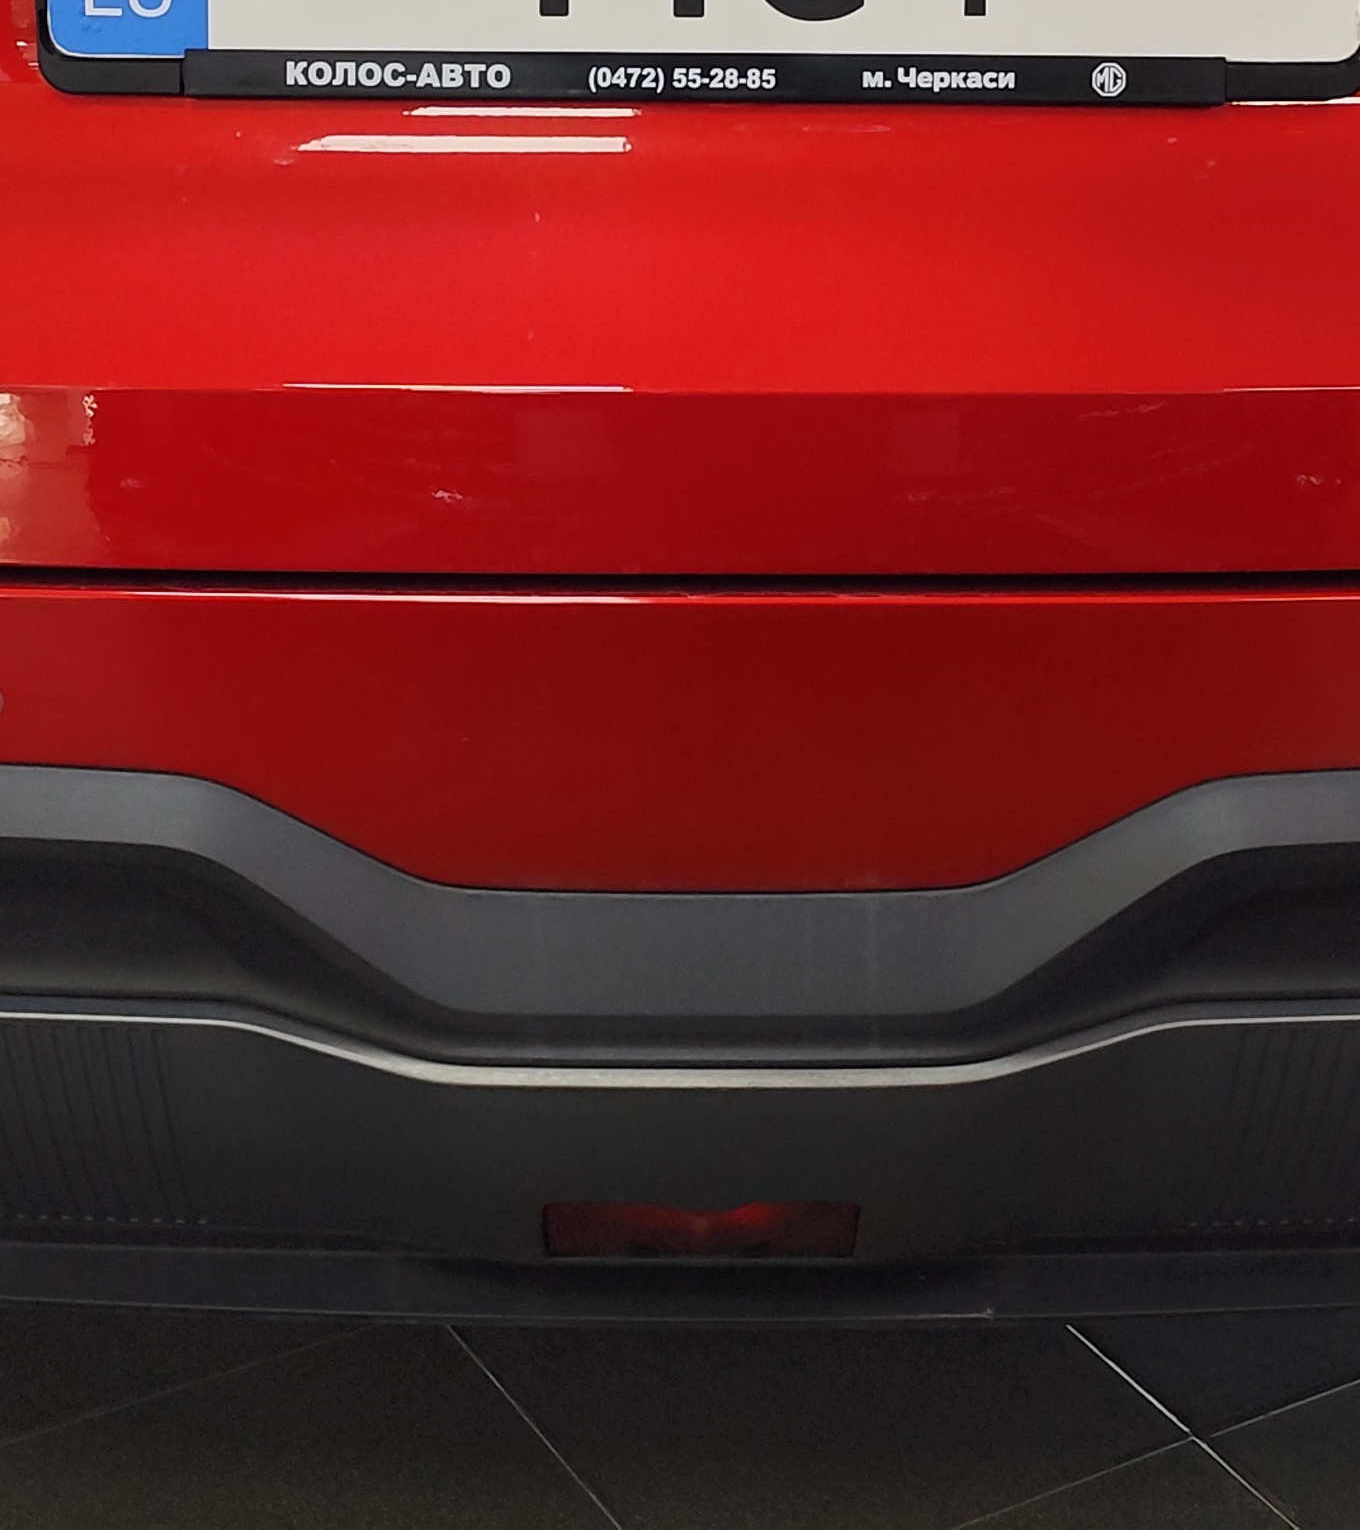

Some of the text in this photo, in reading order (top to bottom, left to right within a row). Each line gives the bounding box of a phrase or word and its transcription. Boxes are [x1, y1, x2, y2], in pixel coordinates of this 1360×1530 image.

[285, 61, 1016, 93] КОЛОС-АВТО (0472) 55-28-85 м. Черкаси
